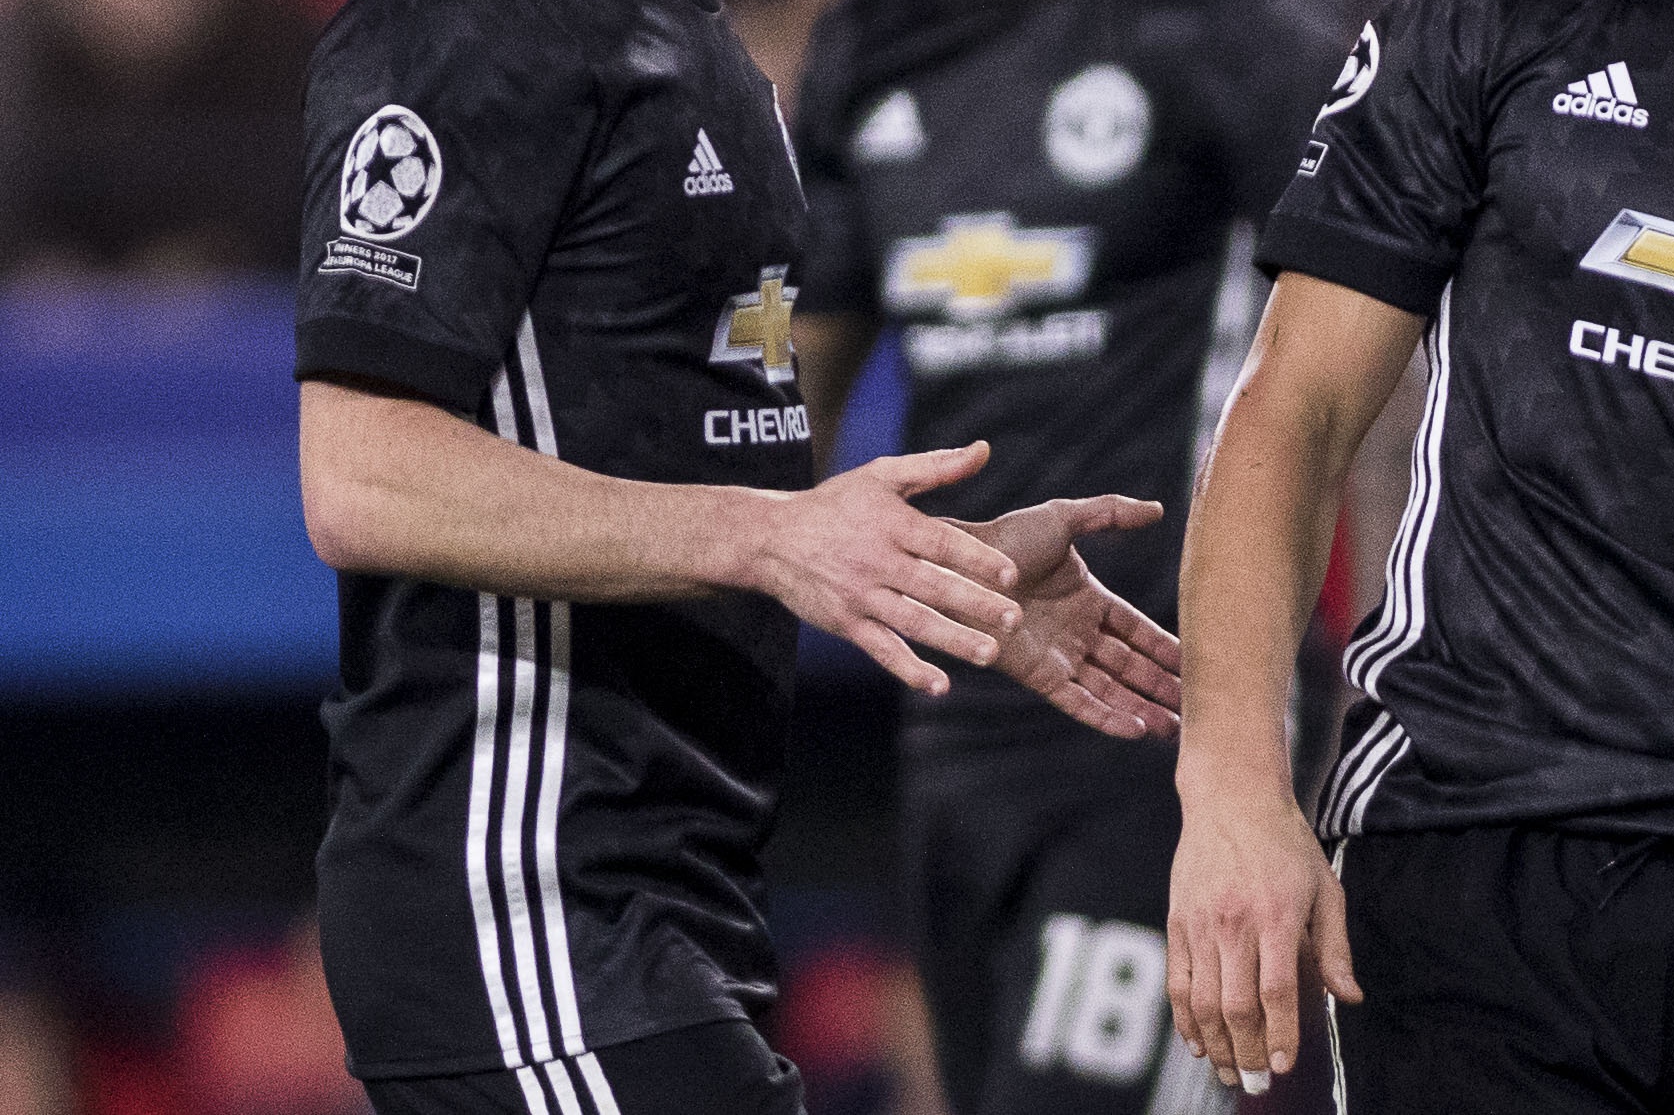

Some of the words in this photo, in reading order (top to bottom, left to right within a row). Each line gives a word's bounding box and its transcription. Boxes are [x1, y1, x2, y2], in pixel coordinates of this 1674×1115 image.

[1552, 91, 1650, 129] adidas
[374, 251, 398, 264] 2017
[374, 262, 414, 283] LEAGUE
[1020, 914, 1167, 1079] 18
